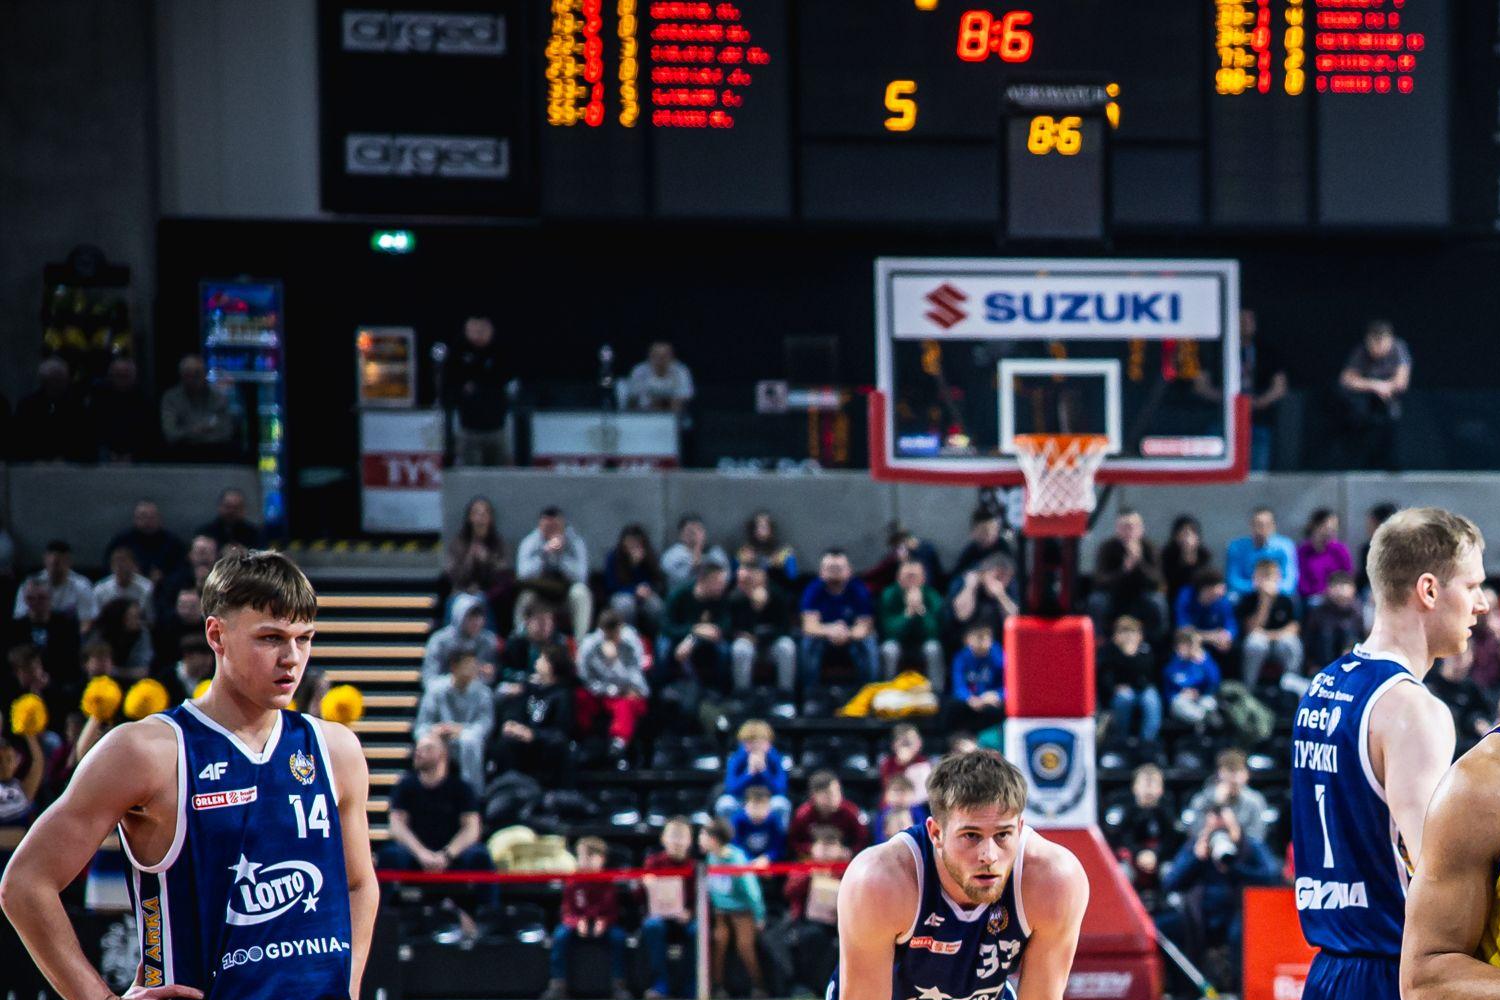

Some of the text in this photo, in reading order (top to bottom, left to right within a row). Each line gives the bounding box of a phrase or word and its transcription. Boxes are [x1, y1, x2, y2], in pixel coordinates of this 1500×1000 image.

[957, 10, 1034, 63] 8:6
[884, 80, 918, 132] 5
[985, 292, 1181, 324] SUZUKI
[199, 762, 229, 781] 4F
[195, 795, 225, 807] ORLEN
[288, 794, 331, 839] 14
[1314, 784, 1335, 869] 1
[239, 871, 305, 913] LOTTO
[143, 896, 162, 961] ARKA
[265, 936, 342, 960] GDYNIA
